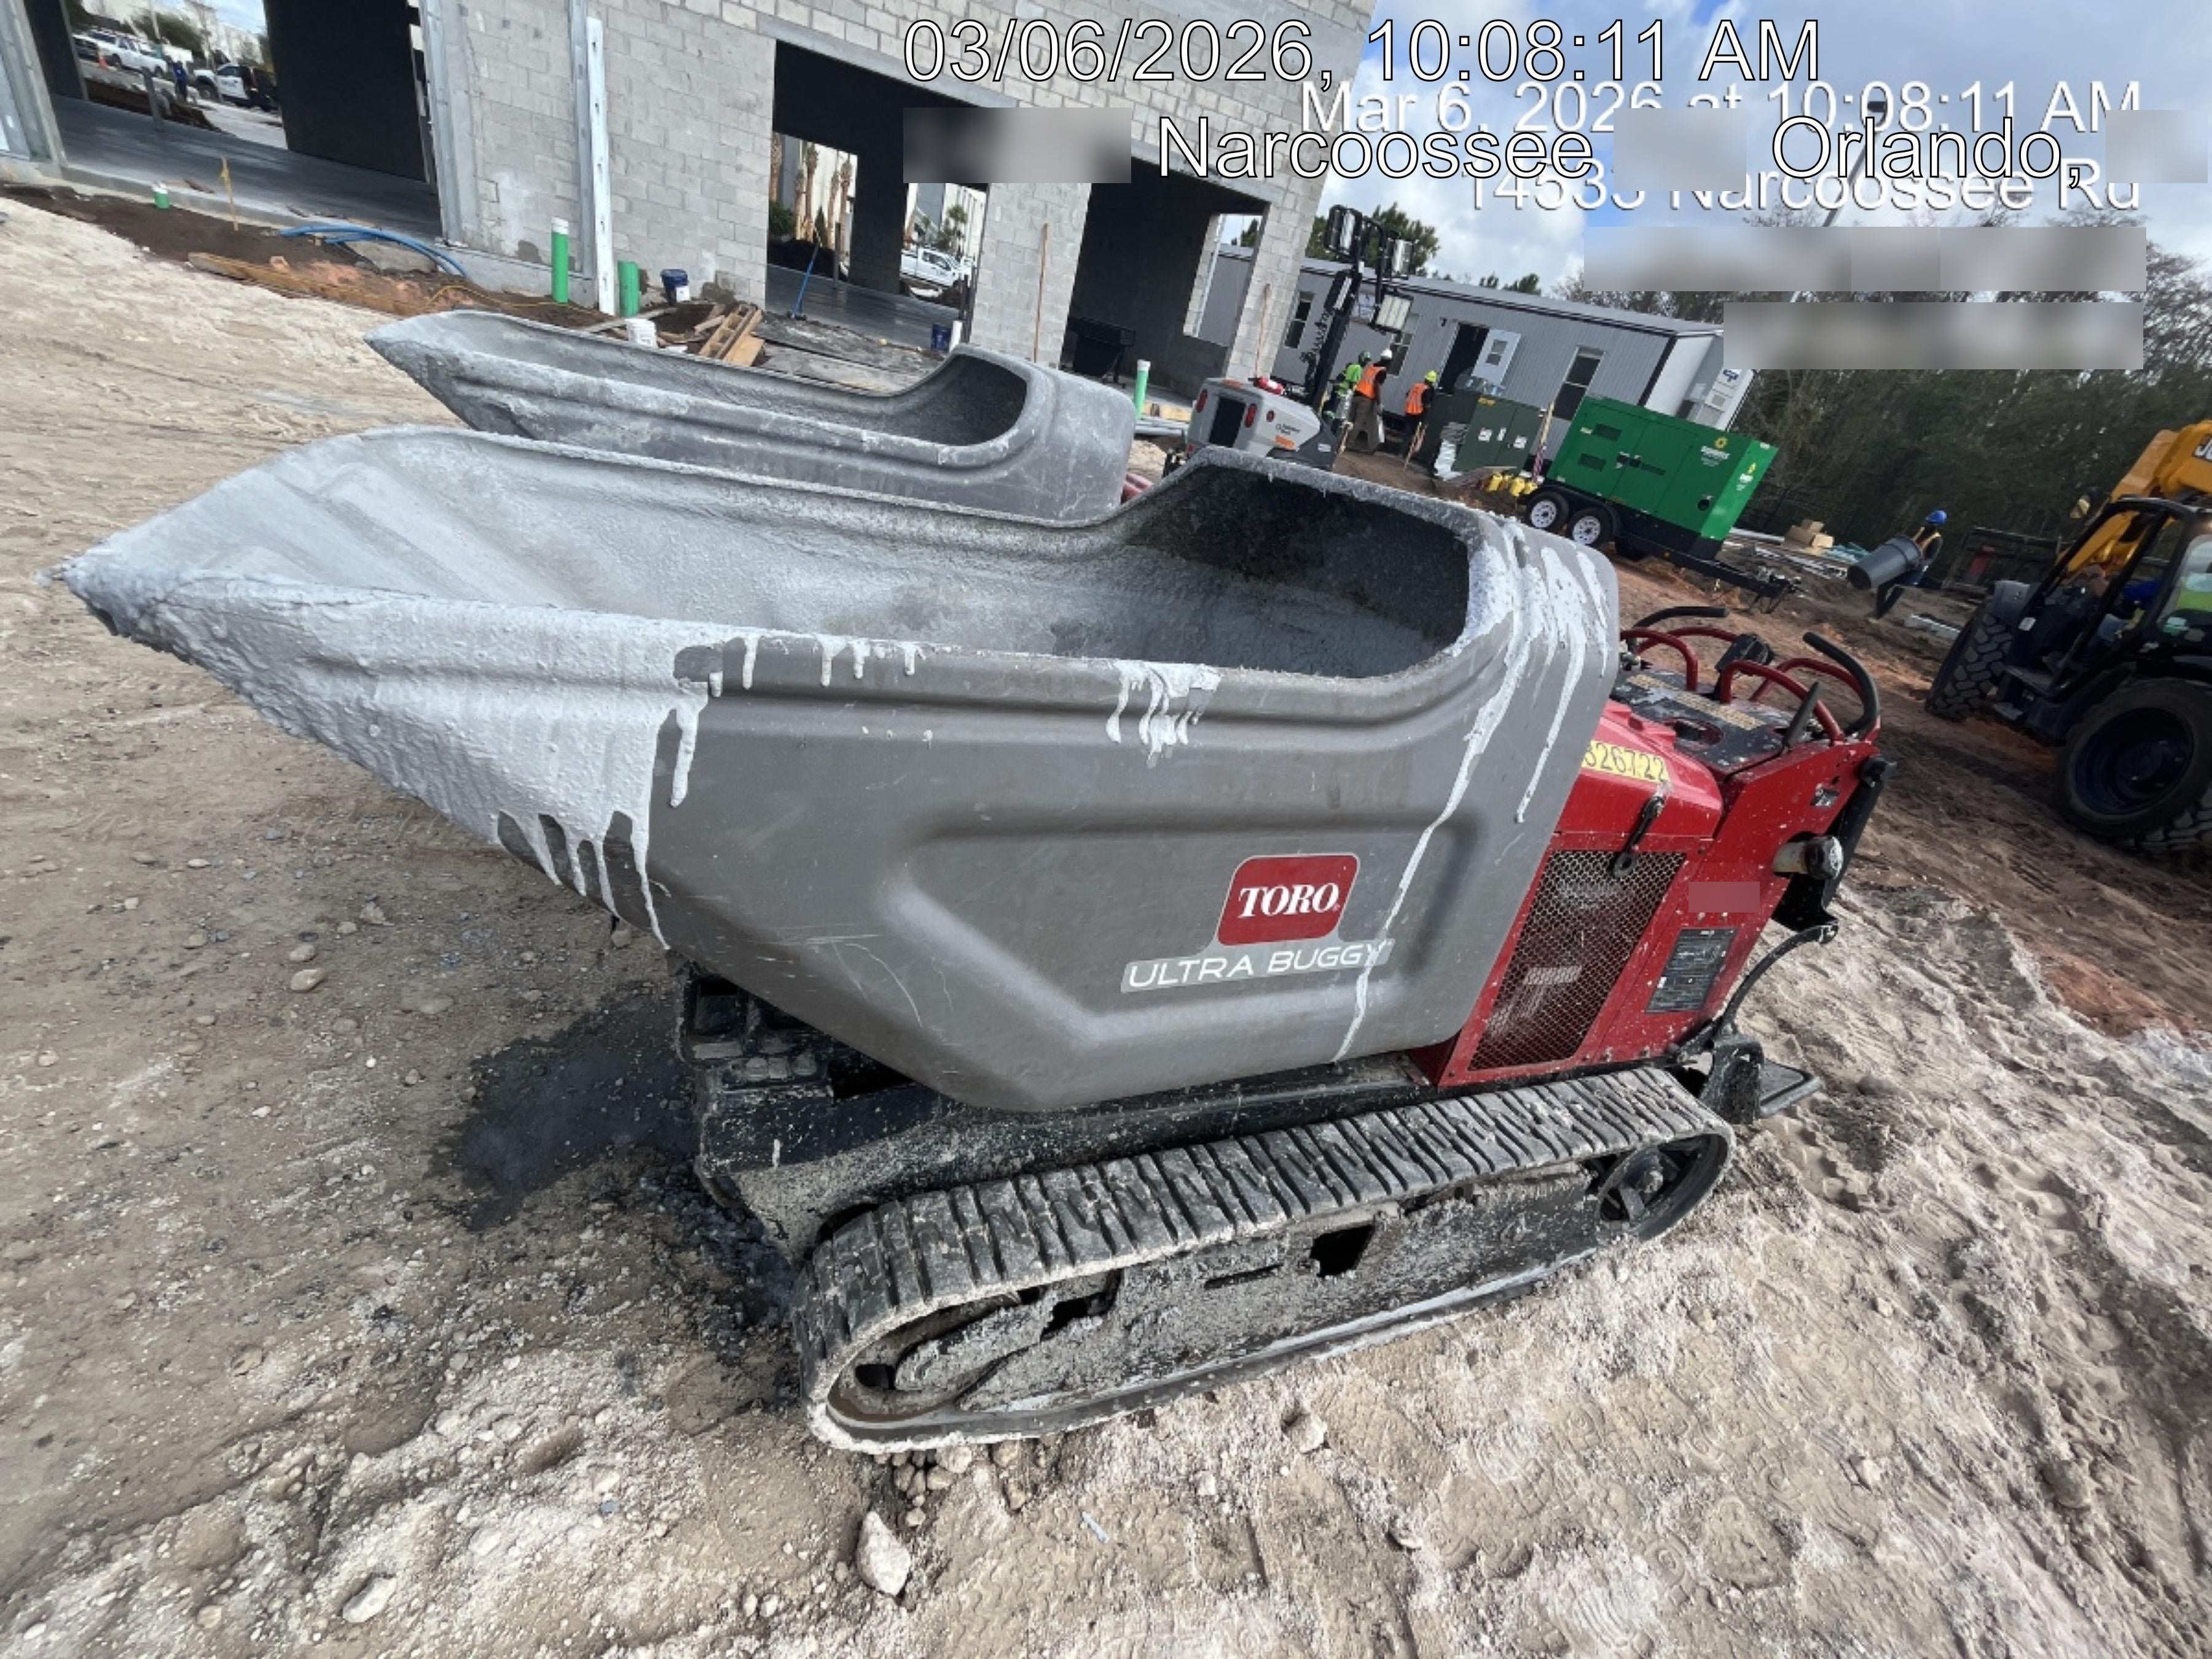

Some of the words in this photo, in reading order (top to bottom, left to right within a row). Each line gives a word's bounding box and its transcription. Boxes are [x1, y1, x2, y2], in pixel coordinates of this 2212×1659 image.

[1237, 882, 1339, 919] TORO
[1129, 955, 1254, 987] ULTRA
[1266, 941, 1385, 974] BUGGY
